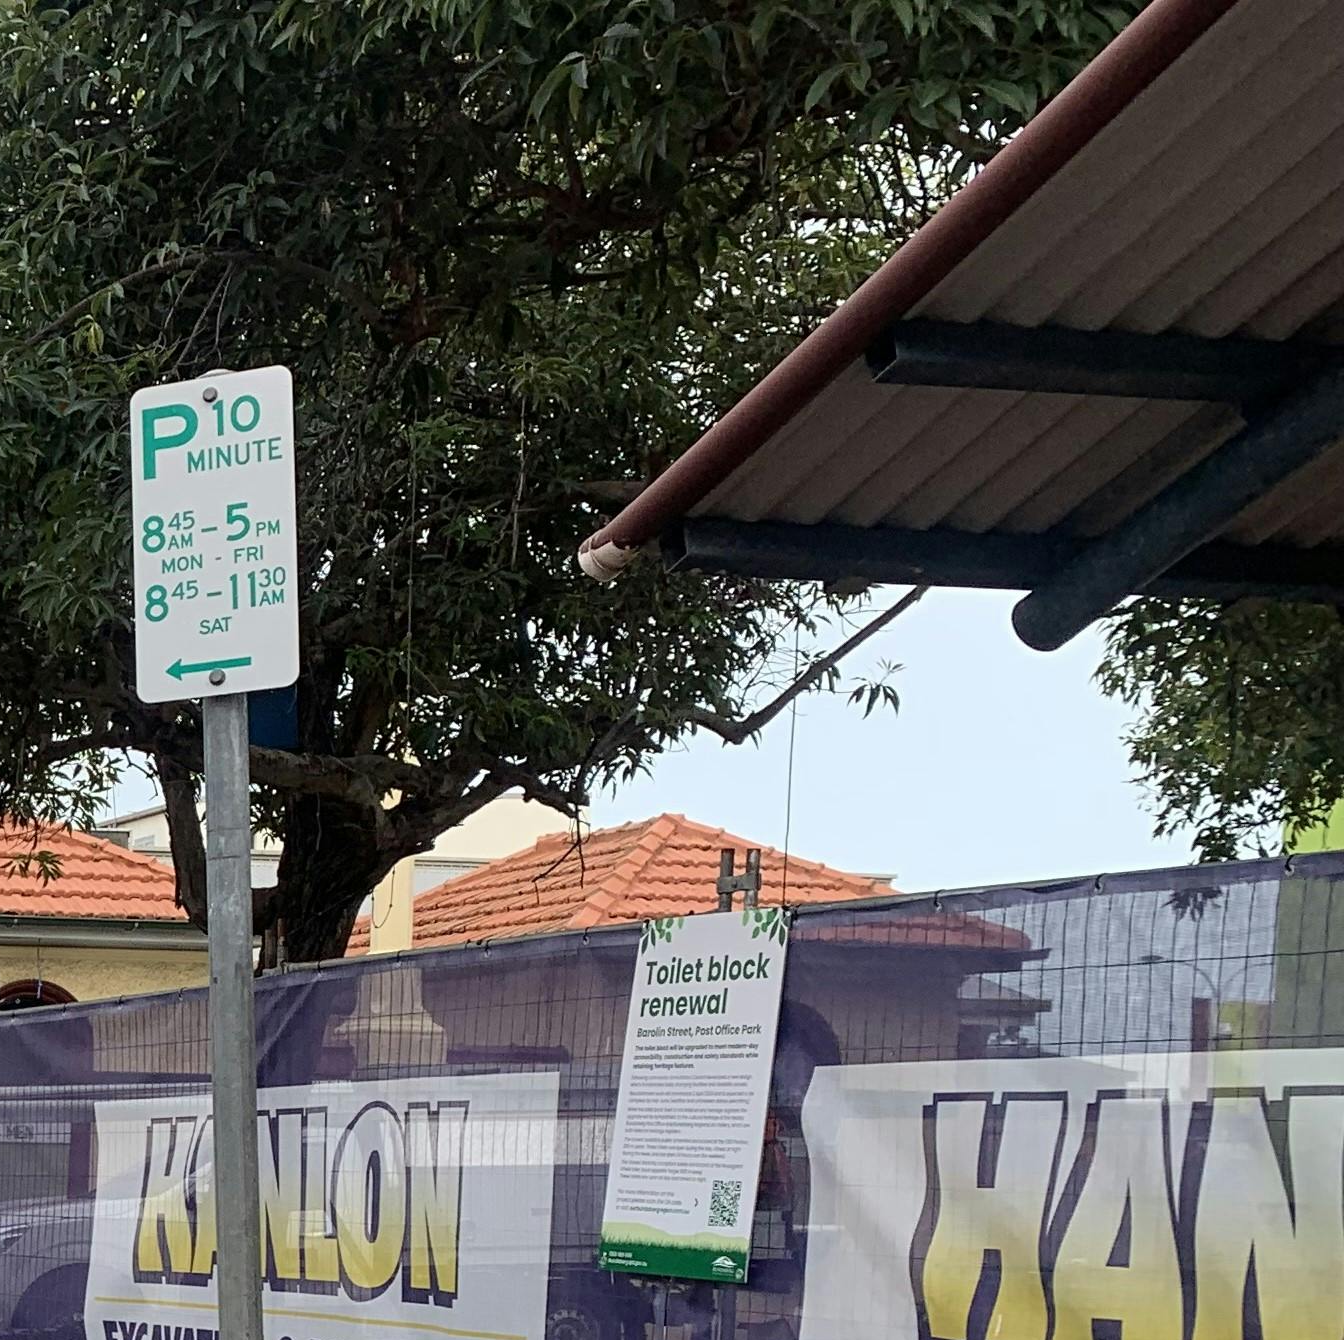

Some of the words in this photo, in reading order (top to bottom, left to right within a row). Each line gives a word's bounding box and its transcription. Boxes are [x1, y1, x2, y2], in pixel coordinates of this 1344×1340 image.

[142, 403, 198, 480] P
[212, 394, 260, 436] 10
[187, 437, 282, 473] MINUTE
[168, 533, 193, 550] AM
[226, 502, 250, 542] 5
[256, 520, 280, 536] PM
[162, 554, 203, 574] MON
[233, 545, 264, 564] FRI
[259, 589, 285, 607] AM
[199, 617, 232, 635] SAT
[646, 957, 703, 985] Toilet
[707, 952, 770, 982] block
[640, 988, 728, 1017] renewal
[637, 1026, 665, 1038] Barolin
[667, 1025, 693, 1038] Street,
[695, 1025, 714, 1036] Post
[715, 1024, 740, 1035] Office
[742, 1024, 762, 1035] Park
